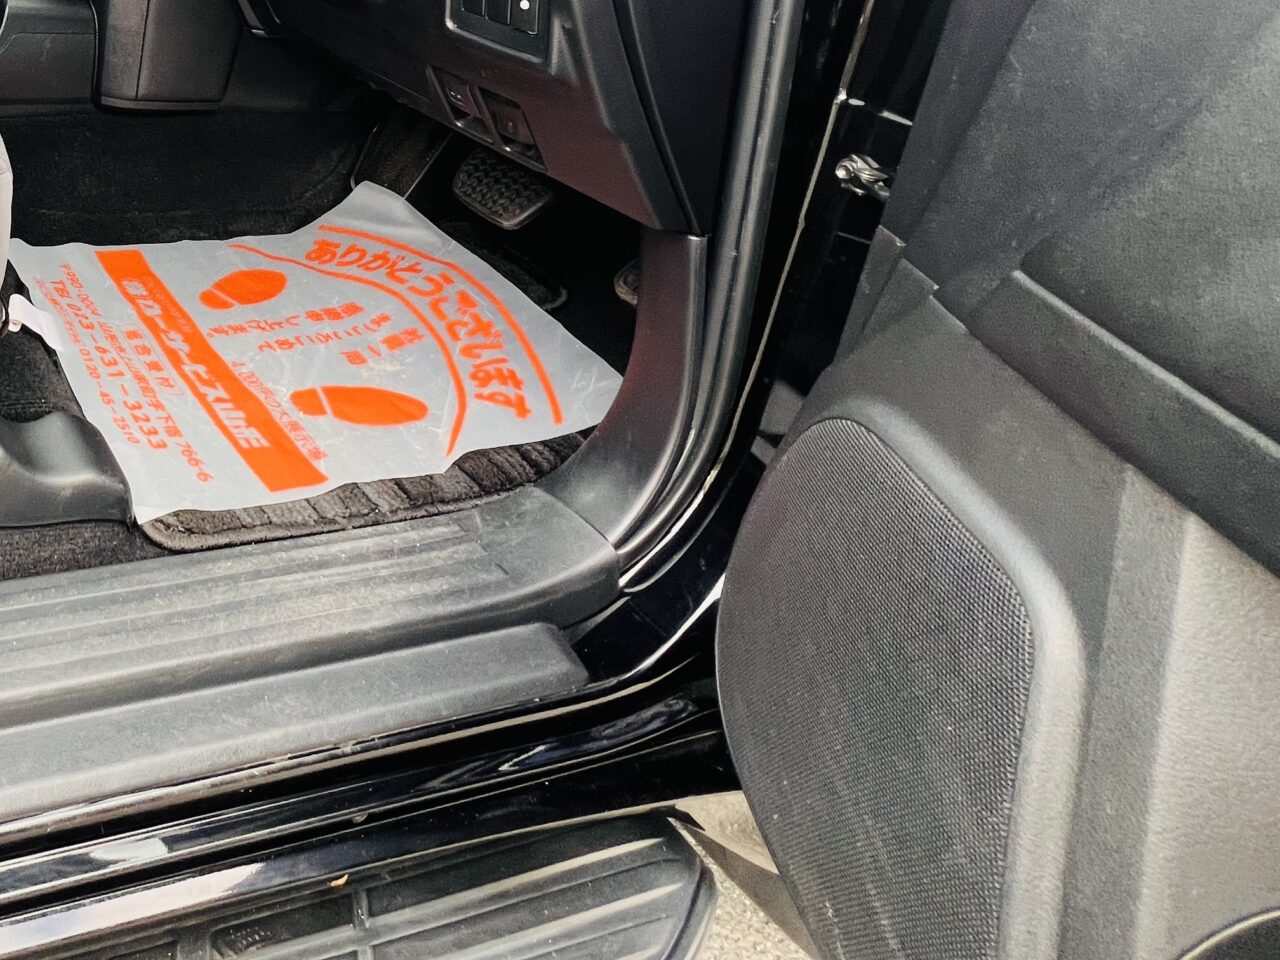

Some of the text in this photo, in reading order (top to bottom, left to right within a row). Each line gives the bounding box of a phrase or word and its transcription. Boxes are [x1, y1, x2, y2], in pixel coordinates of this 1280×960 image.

[304, 239, 532, 421] ありがとうございます
[175, 441, 215, 483] 766-6
